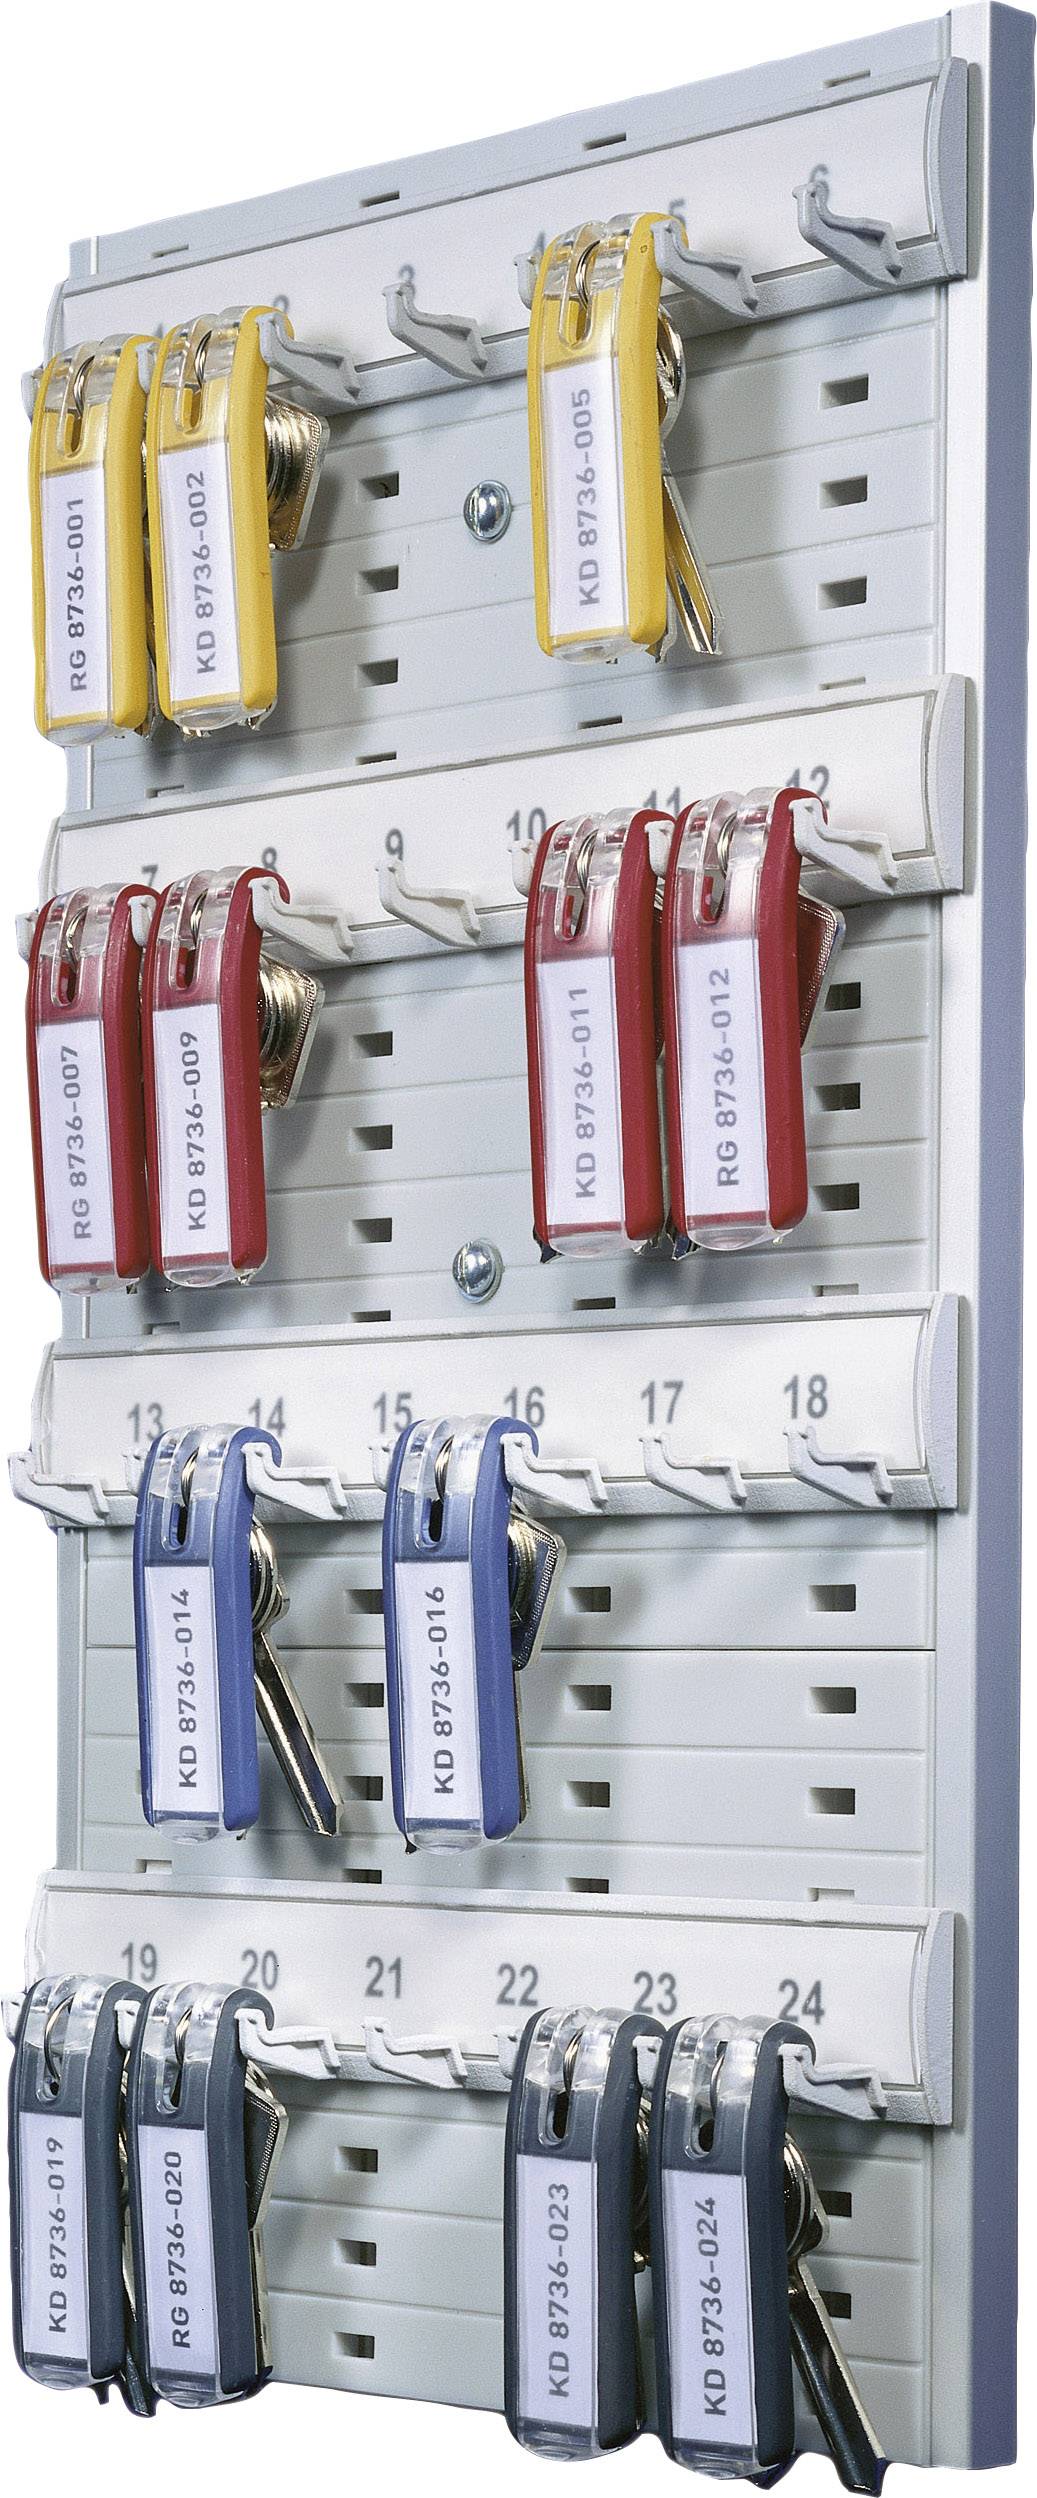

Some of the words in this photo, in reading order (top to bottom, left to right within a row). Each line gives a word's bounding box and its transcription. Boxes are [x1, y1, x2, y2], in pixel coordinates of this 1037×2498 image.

[809, 162, 829, 201] 6
[668, 198, 686, 226] 5
[571, 389, 597, 547] 8736-005
[186, 471, 213, 618] 8736-002
[67, 500, 84, 638] 8736-001
[579, 559, 599, 606] KD
[70, 650, 86, 691] RG
[197, 631, 215, 673] KD
[643, 786, 682, 820] 11
[785, 764, 831, 803] 12
[384, 828, 404, 860] 9
[506, 807, 547, 842] 10
[141, 864, 159, 887] 7
[261, 847, 278, 873] 8
[568, 989, 595, 1139] 8736-011
[709, 969, 737, 1127] 8736-012
[61, 1046, 87, 1187] 8736-007
[180, 1032, 205, 1176] 8736-009
[576, 1153, 595, 1198] KD
[717, 1141, 739, 1186] RG
[72, 1199, 91, 1239] RG
[188, 1189, 206, 1230] KD
[248, 1396, 286, 1437] 14
[373, 1391, 413, 1434] 15
[503, 1385, 546, 1428] 16
[640, 1379, 685, 1425] 17
[783, 1373, 828, 1419] 18
[127, 1402, 164, 1443] 13
[171, 1589, 196, 1733] 8736-014
[426, 1587, 452, 1736] 8736-016
[179, 1746, 196, 1787] KD
[434, 1750, 454, 1793] KD
[121, 1942, 158, 1982] 19
[240, 1949, 279, 1991] 20
[365, 1956, 402, 1999] 21
[497, 1964, 539, 2007] 22
[633, 1971, 677, 2016] 23
[778, 1978, 826, 2025] 24
[47, 2138, 67, 2279] 8736-019
[164, 2152, 187, 2296] 8736-020
[548, 2184, 569, 2339] 8736-023
[695, 2198, 724, 2356] 8736-024
[49, 2291, 66, 2332] KD
[171, 2307, 190, 2348] RG
[549, 2351, 569, 2397] KD
[704, 2369, 726, 2416] KD
